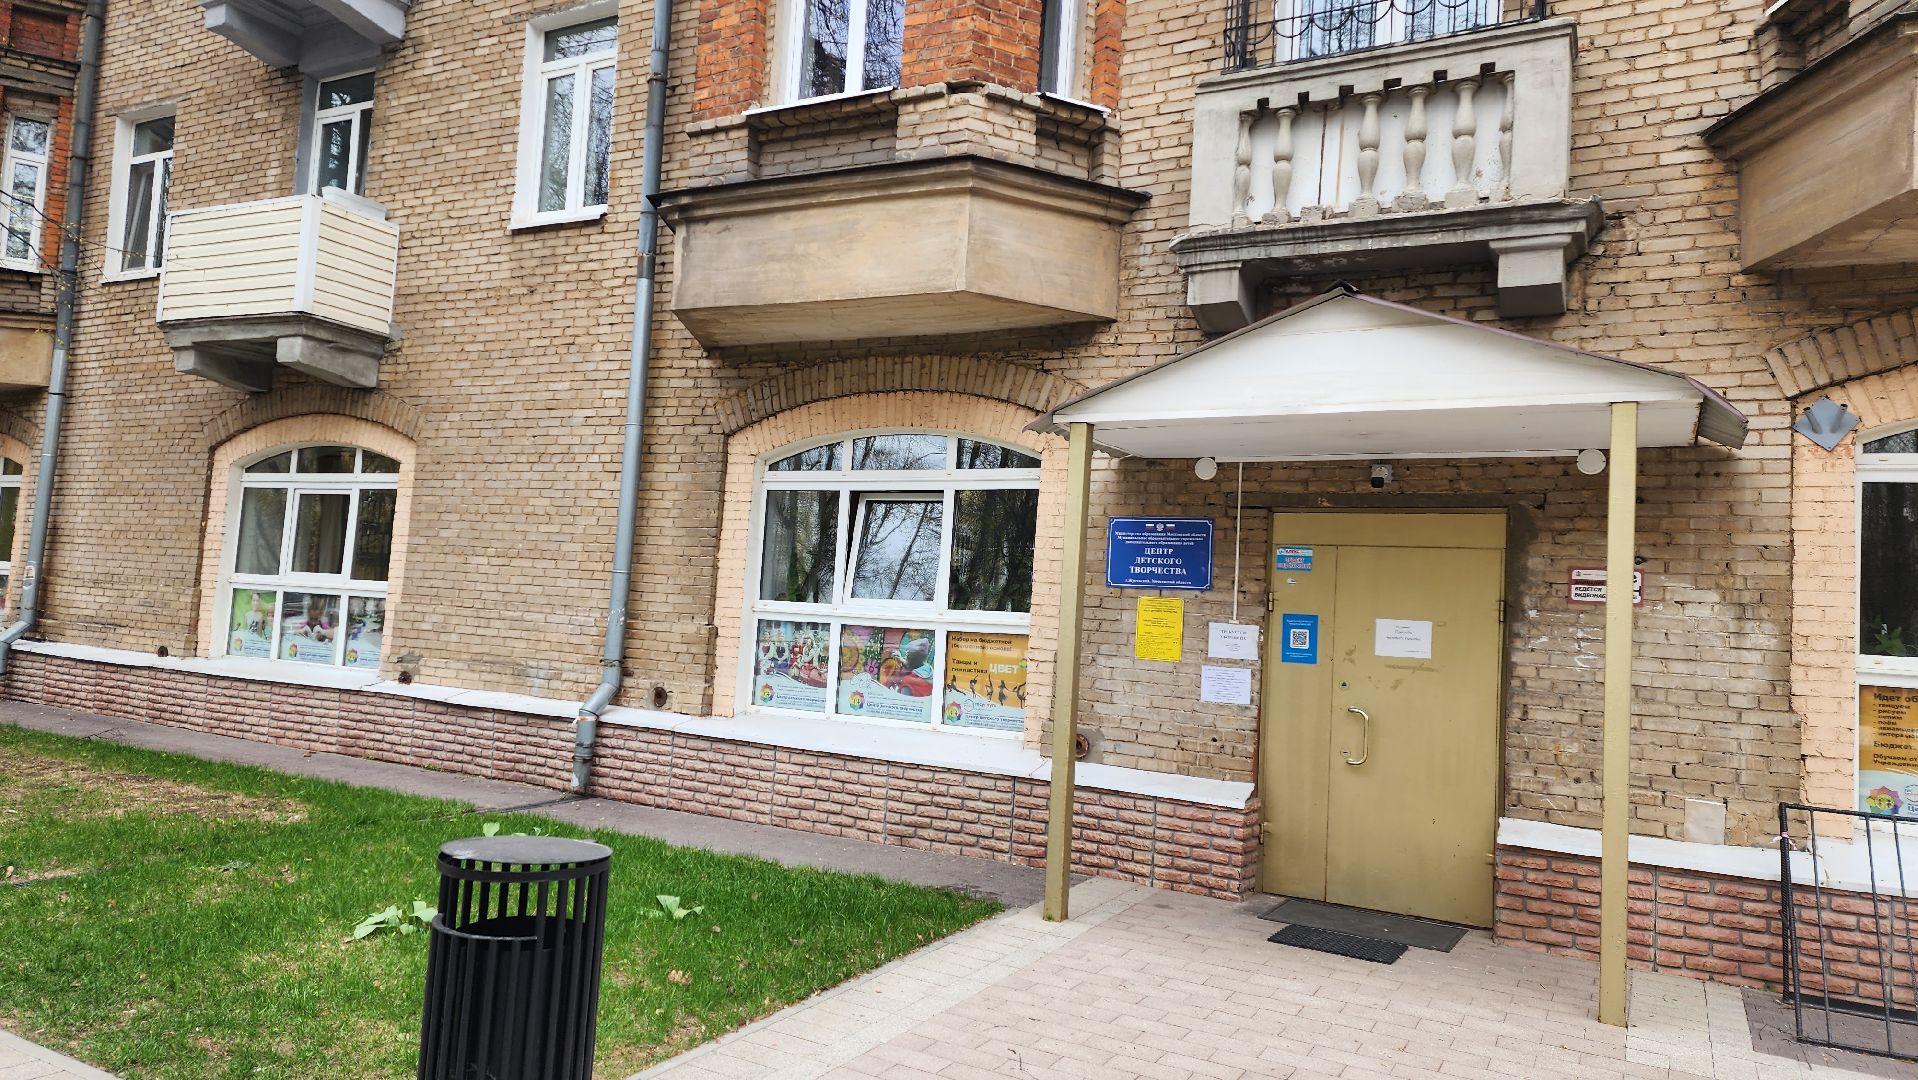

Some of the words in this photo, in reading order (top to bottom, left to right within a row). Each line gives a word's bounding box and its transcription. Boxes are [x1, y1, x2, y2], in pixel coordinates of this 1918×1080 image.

[1144, 547, 1174, 555] ЦЕНТР
[1134, 556, 1182, 565] ДЕТСКОГО
[1129, 565, 1187, 575] ТВОРЧЕСТВА
[951, 635, 969, 643] Набор
[952, 658, 972, 666] Танцы
[989, 663, 1019, 674] ЦВЕТ
[1874, 693, 1901, 702] Идет
